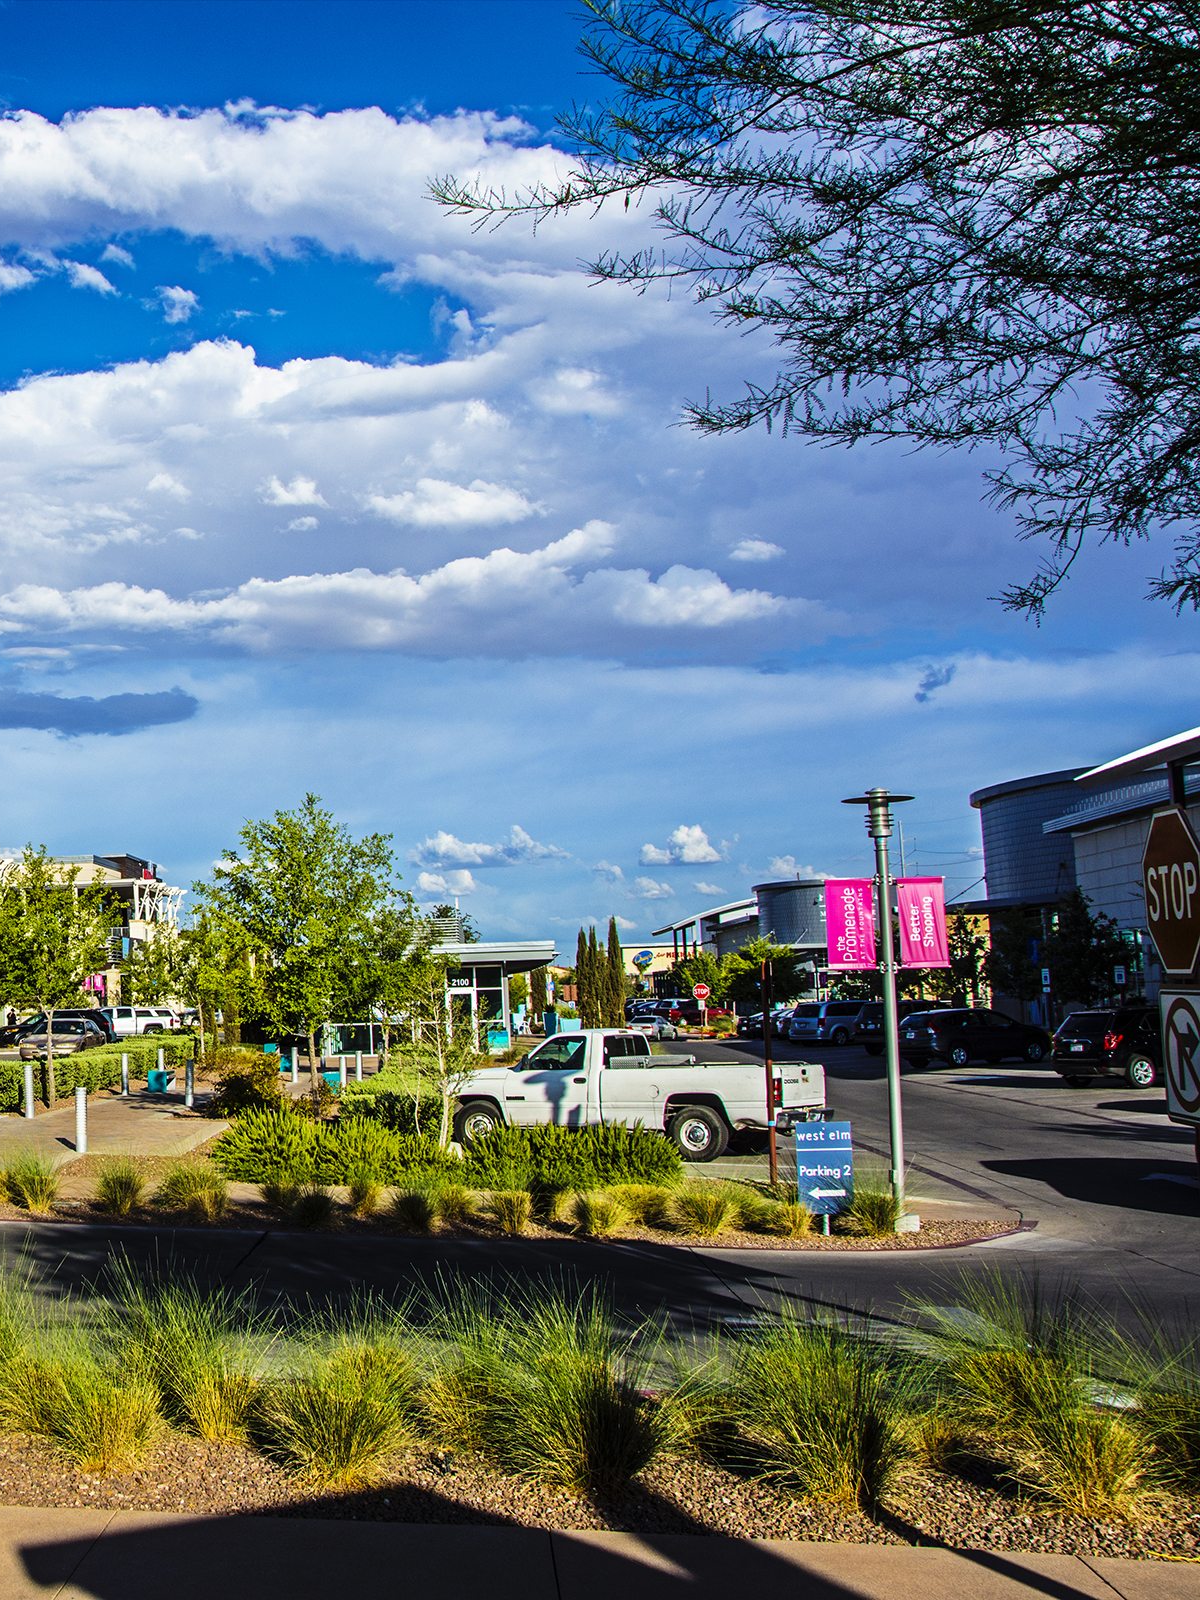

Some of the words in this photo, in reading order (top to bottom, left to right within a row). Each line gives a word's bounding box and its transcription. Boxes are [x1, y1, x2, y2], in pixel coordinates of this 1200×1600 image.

[1148, 862, 1197, 921] STOP
[857, 888, 865, 931] FOUNTAINS
[910, 903, 921, 942] Better
[921, 896, 934, 947] Shopping
[841, 887, 857, 961] Promenade
[836, 936, 846, 951] the
[861, 951, 866, 959] AT
[451, 978, 469, 987] 2100
[796, 1130, 825, 1141] west
[829, 1130, 851, 1140] elm
[799, 1164, 841, 1179] Parking
[843, 1164, 852, 1176] 2
